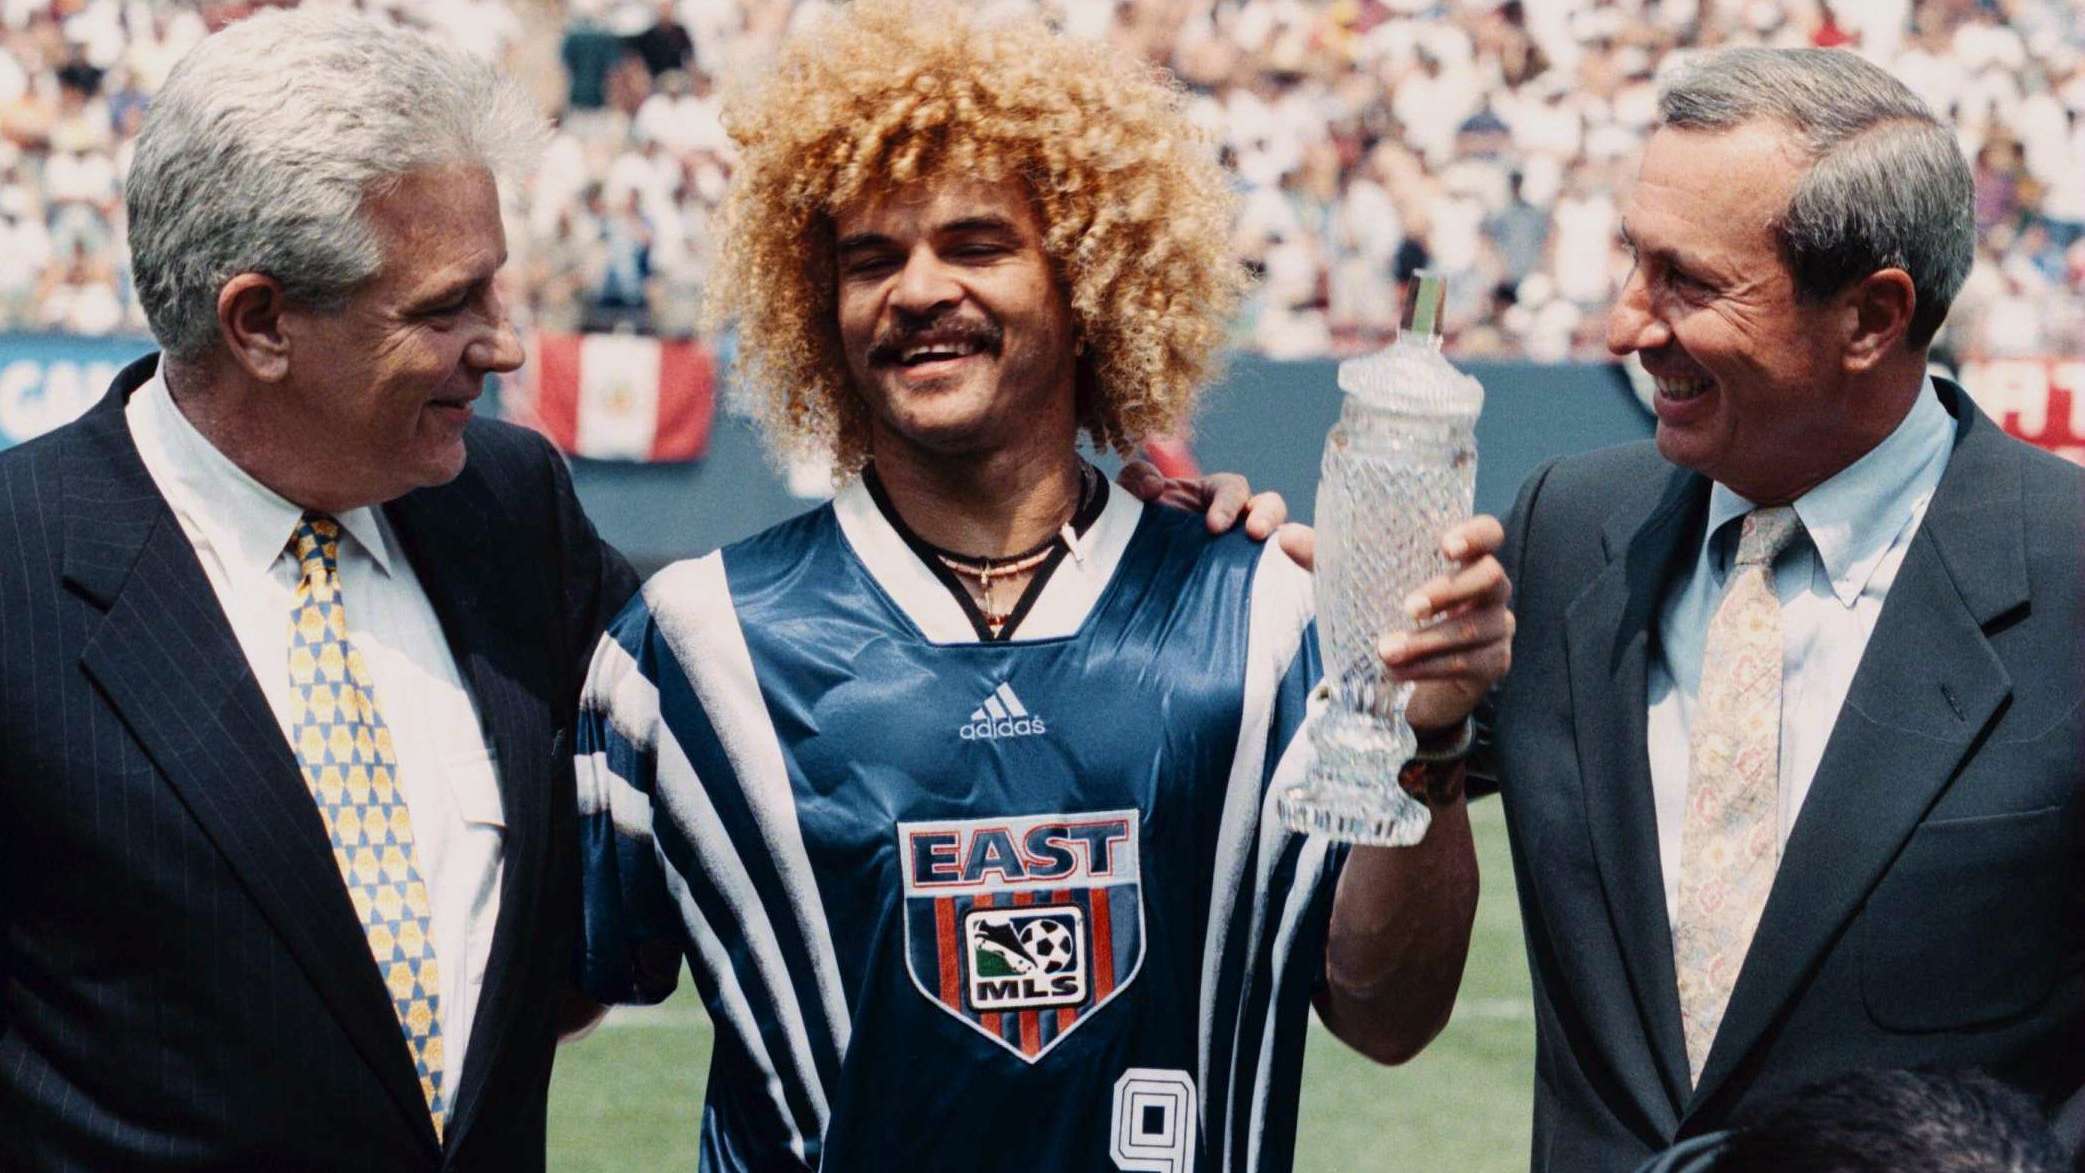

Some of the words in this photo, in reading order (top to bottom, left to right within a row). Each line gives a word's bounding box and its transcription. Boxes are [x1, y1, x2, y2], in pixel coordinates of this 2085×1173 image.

[960, 715, 1046, 740] adidas
[910, 820, 1128, 888] EAST
[976, 975, 1079, 1001] MLS
